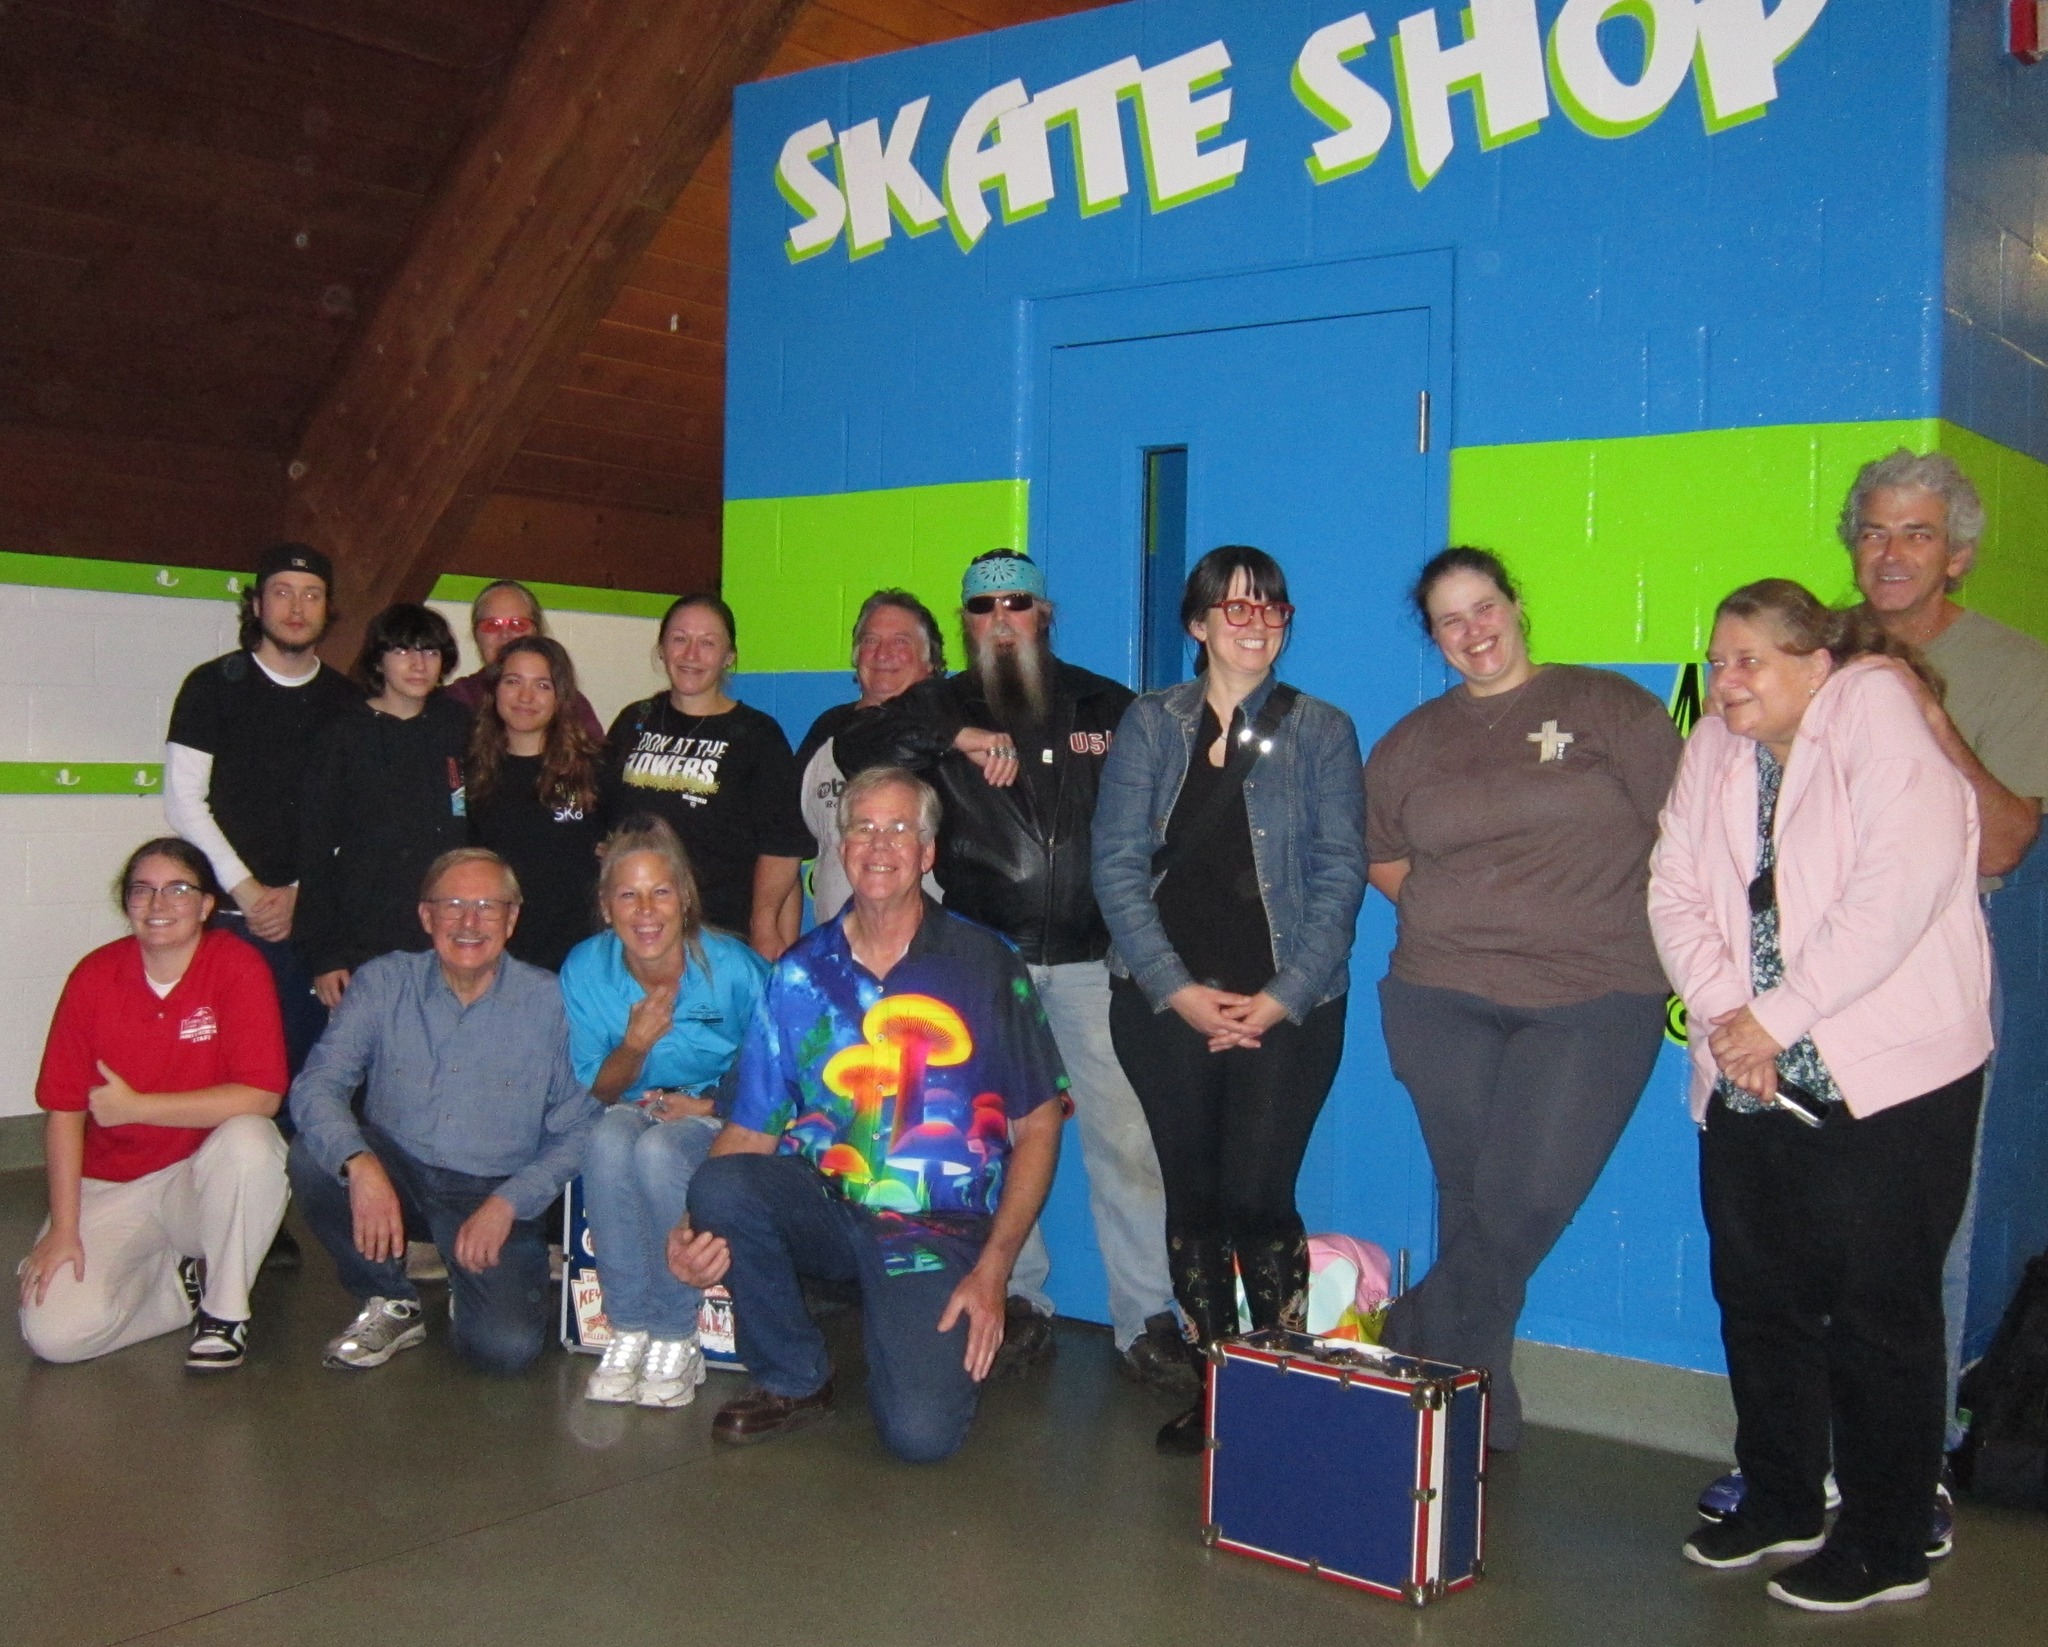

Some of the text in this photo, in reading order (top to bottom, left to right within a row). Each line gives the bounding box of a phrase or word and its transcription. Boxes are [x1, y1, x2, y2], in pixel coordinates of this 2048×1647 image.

[775, 0, 1828, 264] SKATE SHOP
[633, 731, 729, 760] OOK AT THE
